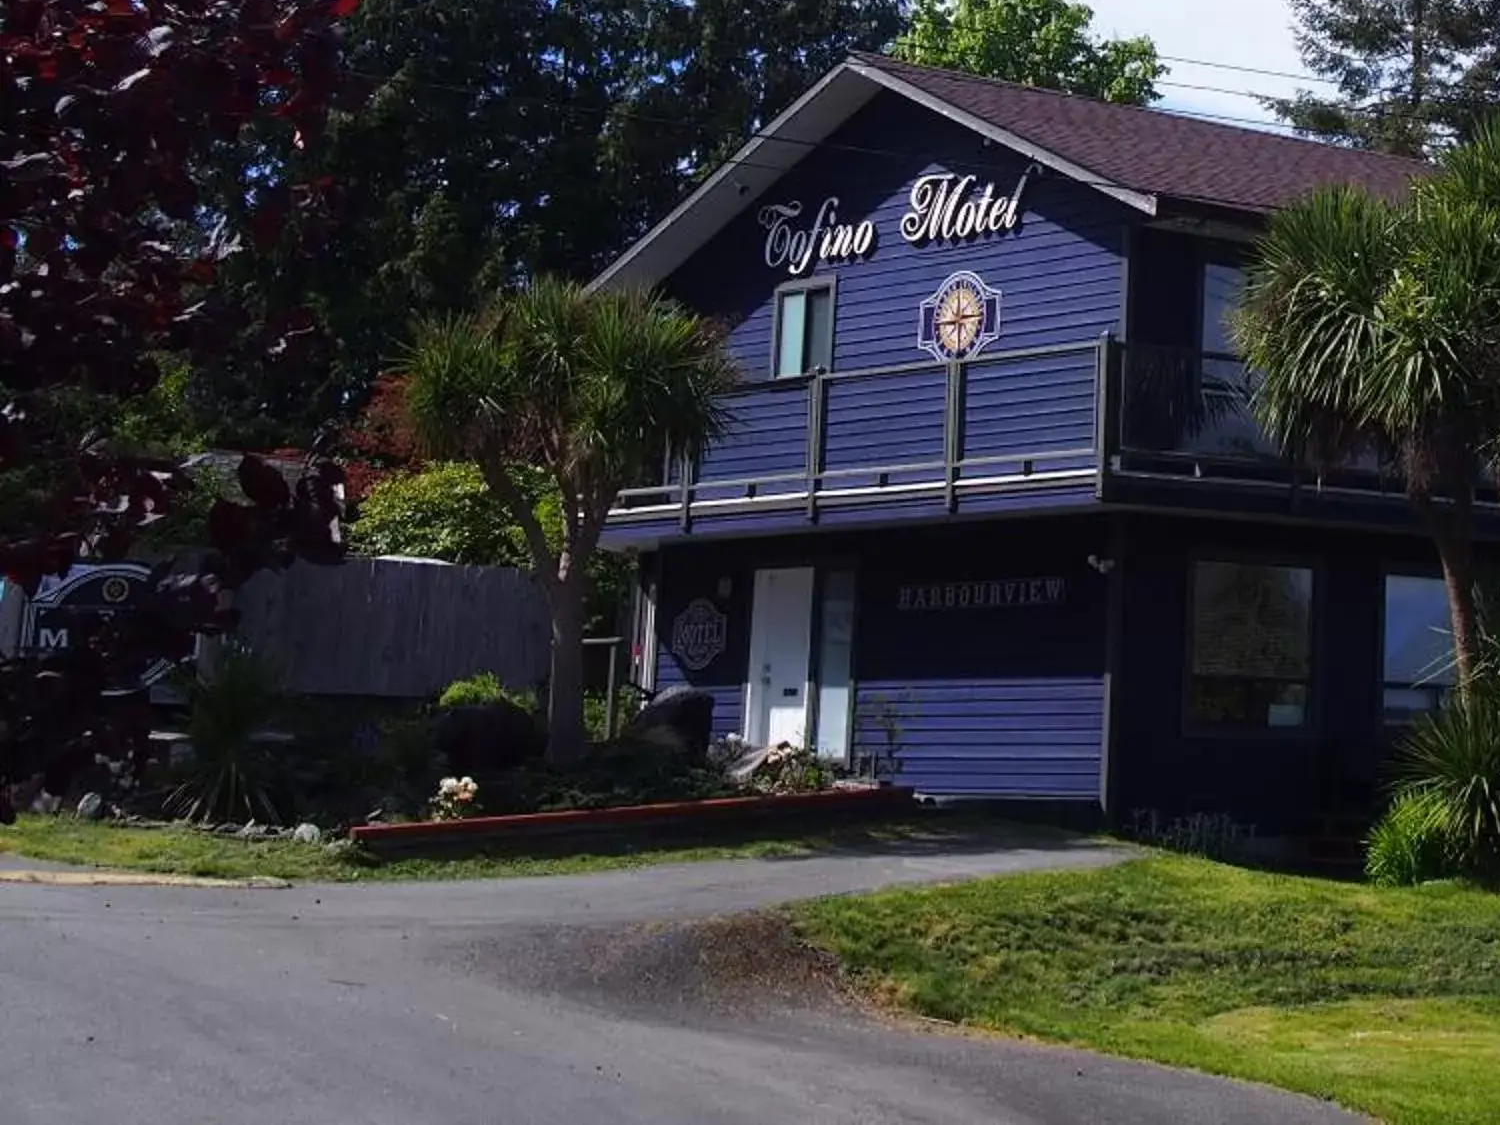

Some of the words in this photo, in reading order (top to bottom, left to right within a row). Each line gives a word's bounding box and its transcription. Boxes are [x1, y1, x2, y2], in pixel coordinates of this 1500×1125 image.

[757, 195, 873, 274] Tofino
[901, 164, 1042, 241] Motel
[899, 577, 1063, 608] HARBOURVIEW
